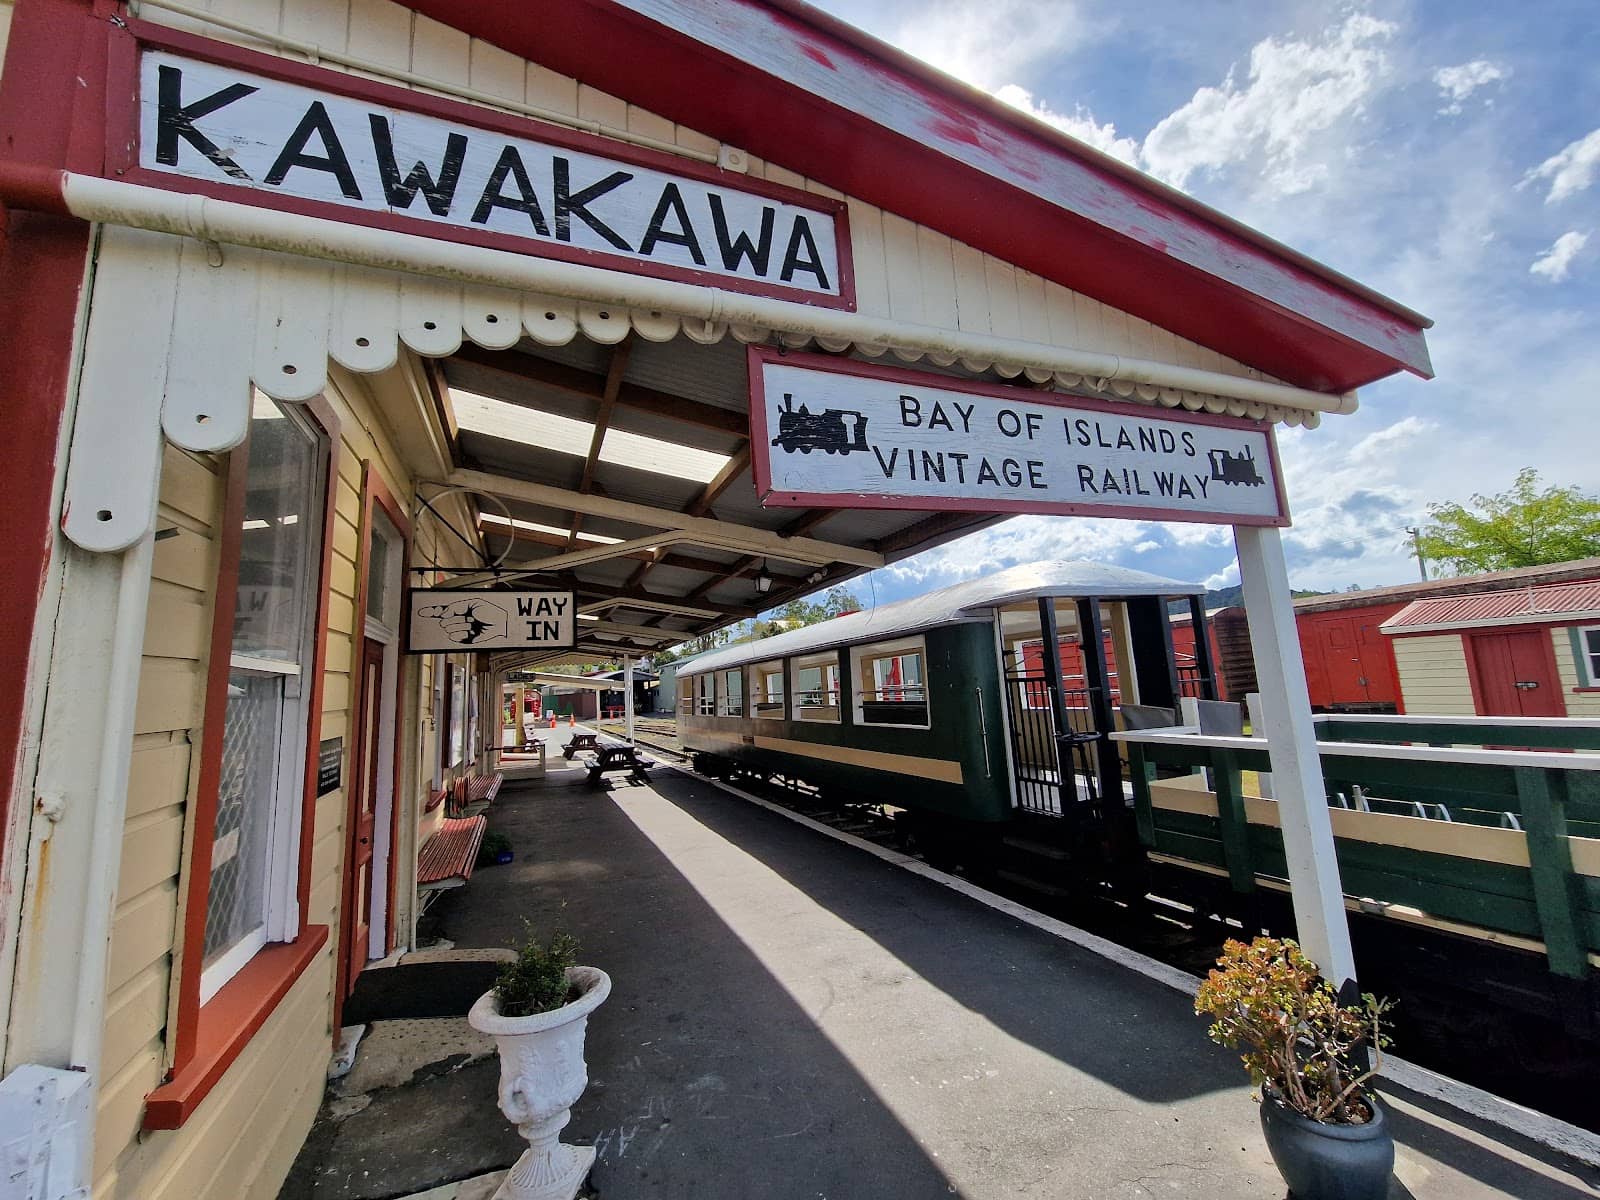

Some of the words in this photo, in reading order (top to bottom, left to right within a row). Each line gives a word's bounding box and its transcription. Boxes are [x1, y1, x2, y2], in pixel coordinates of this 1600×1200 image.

[156, 65, 831, 290] KAWAKAWA
[900, 395, 975, 433] BAY
[996, 409, 1044, 440] OF
[1064, 418, 1196, 457] ISLANDS
[872, 445, 1048, 489] VINTAGE
[1077, 464, 1209, 499] RAILWAY
[516, 597, 568, 617] WAY
[526, 620, 560, 641] IN
